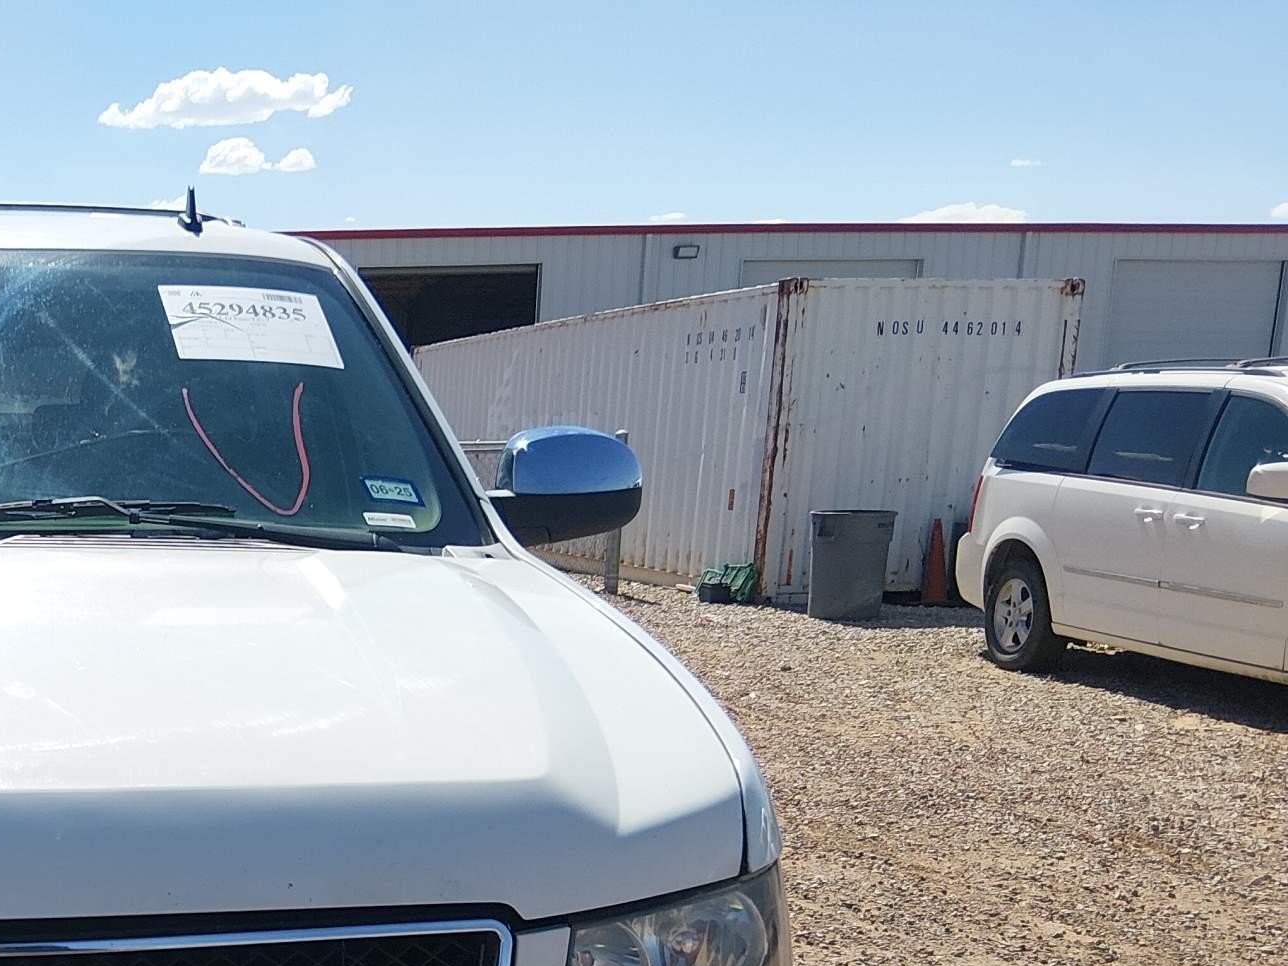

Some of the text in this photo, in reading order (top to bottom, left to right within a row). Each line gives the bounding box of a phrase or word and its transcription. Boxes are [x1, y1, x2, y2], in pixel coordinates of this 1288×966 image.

[182, 301, 307, 322] 45294835
[876, 319, 1023, 337] NOSU 4462014
